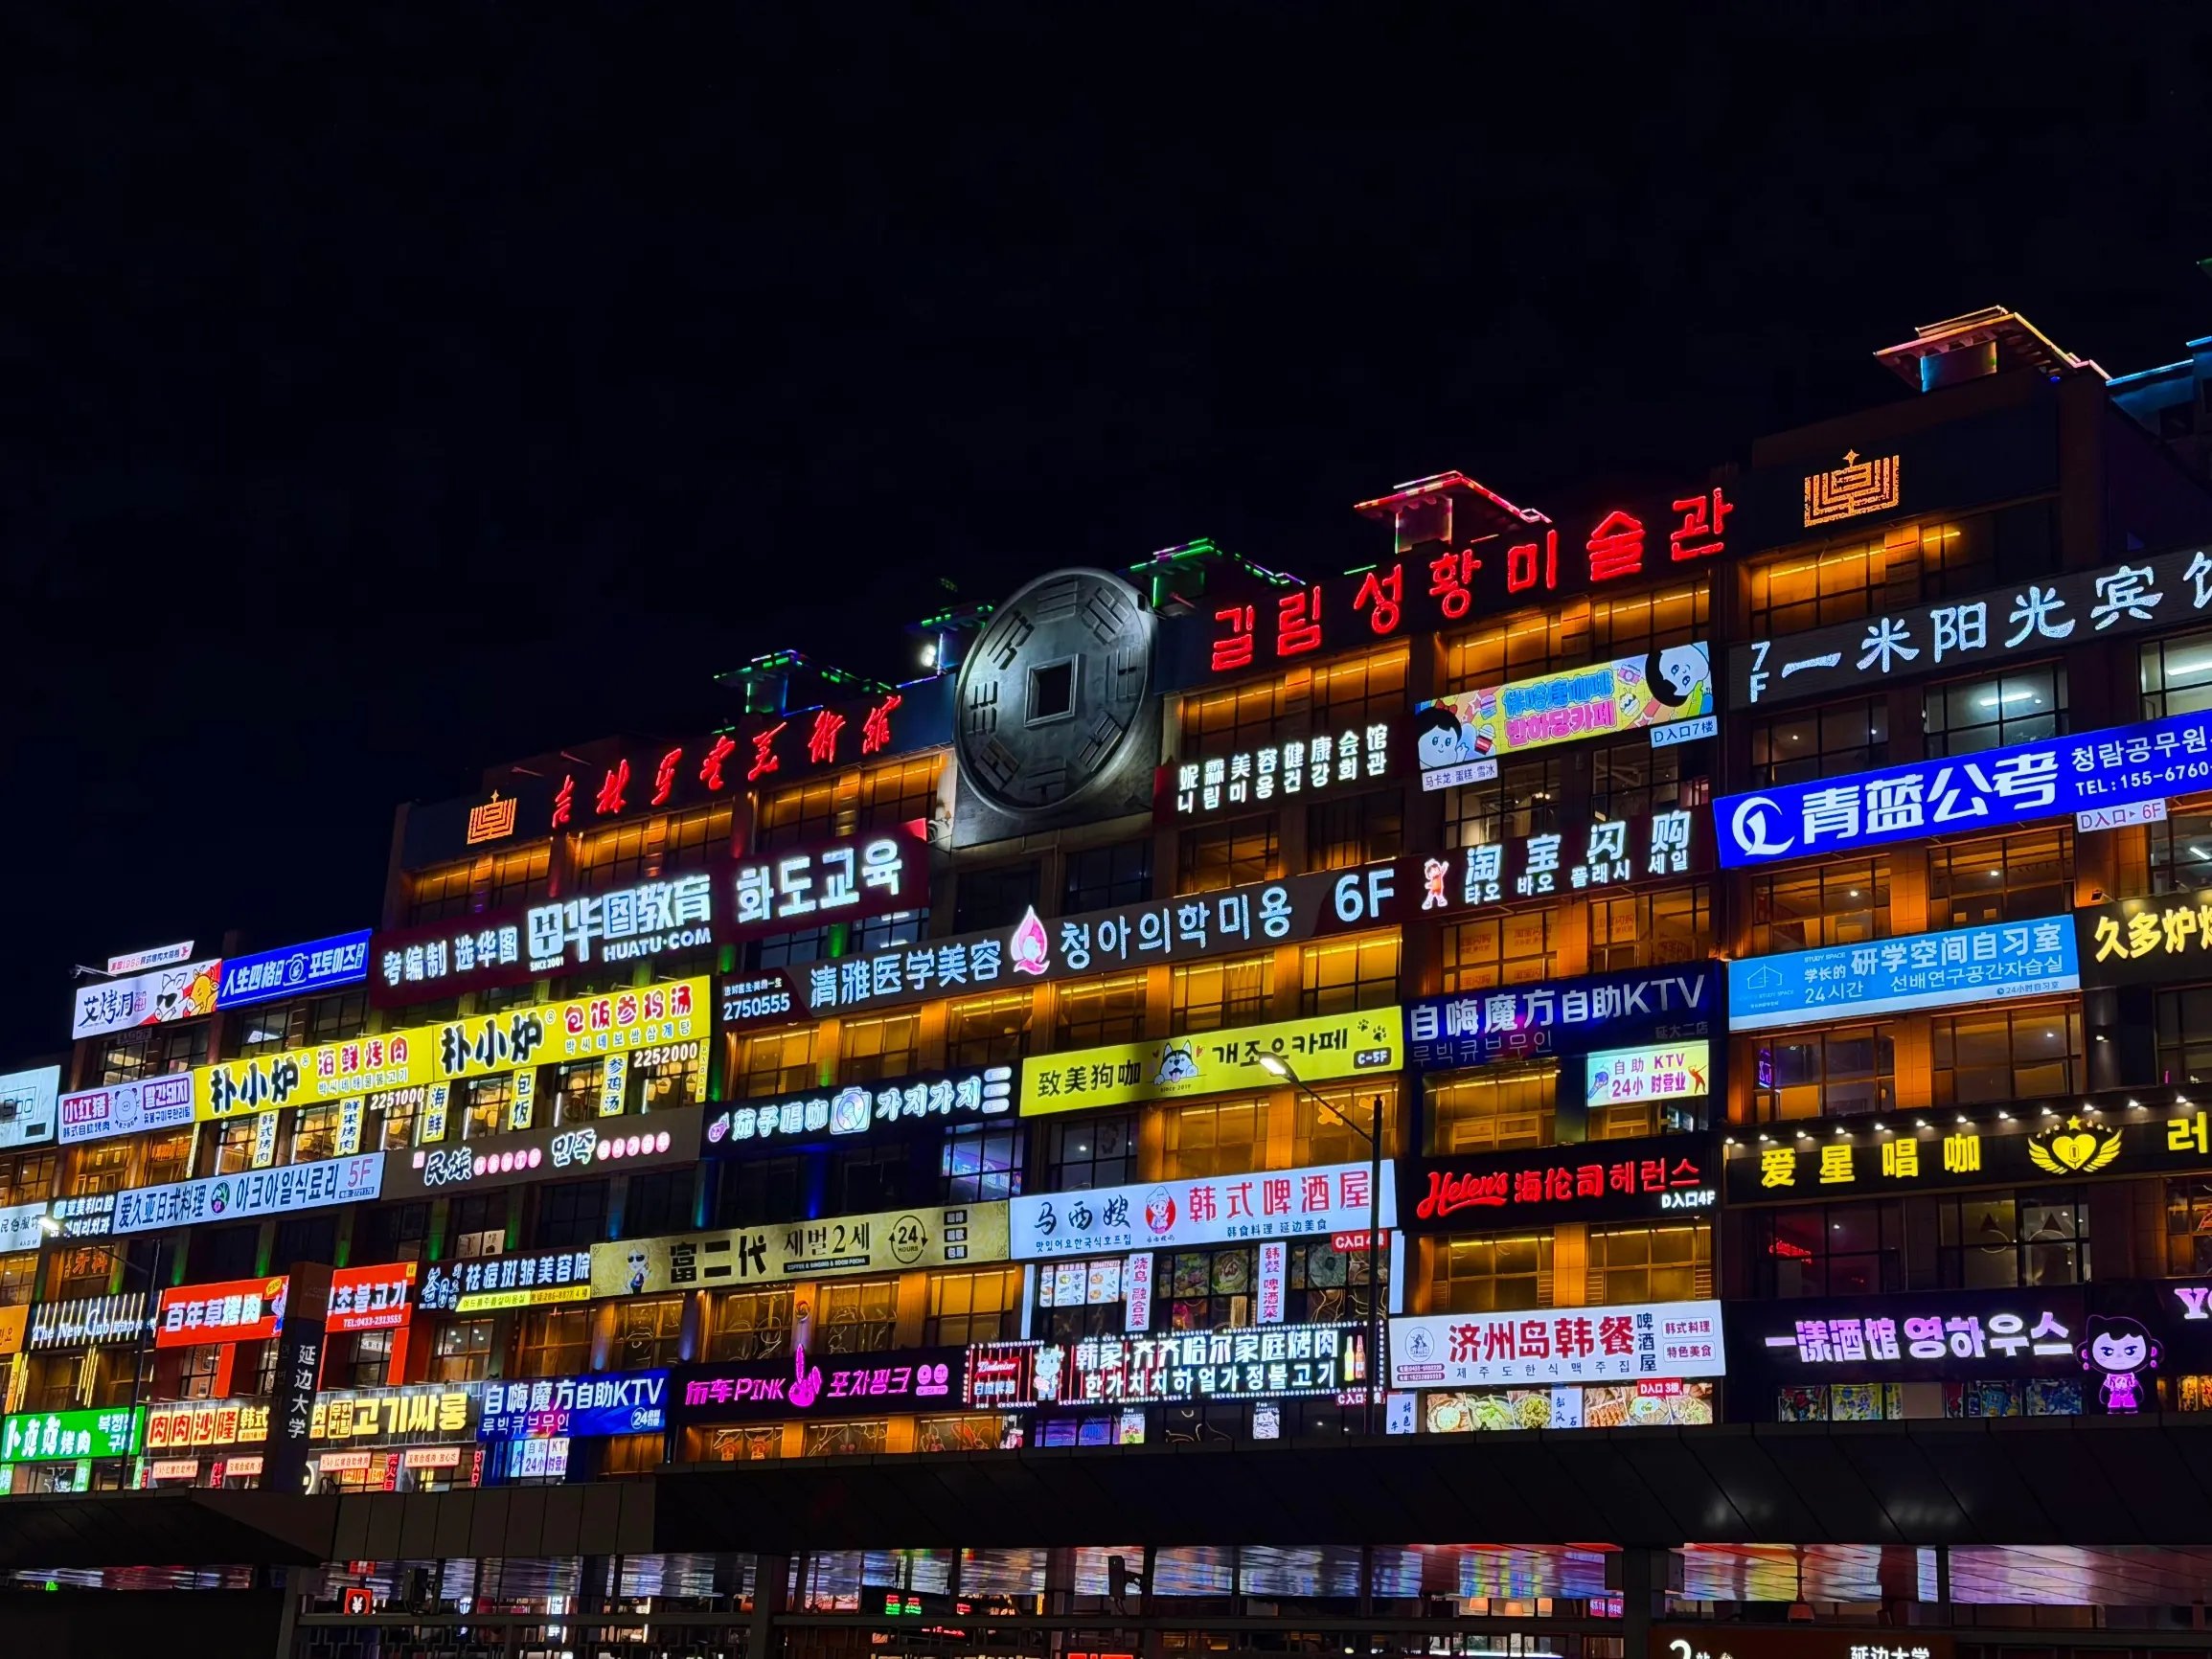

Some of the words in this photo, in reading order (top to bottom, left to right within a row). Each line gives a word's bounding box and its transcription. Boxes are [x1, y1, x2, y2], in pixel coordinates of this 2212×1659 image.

[1212, 488, 1733, 671] 길림성황미술관
[1176, 750, 1388, 814] 니림미용건강회관
[1801, 750, 2060, 845] 青蓝公考
[1465, 810, 1692, 887] 淘宝闪购
[737, 838, 902, 924] 화도교육
[1334, 868, 1396, 923] 6F
[563, 873, 712, 963] 华图教育
[1060, 886, 1293, 970] 청아의학미용
[384, 940, 447, 987] 考编制
[455, 926, 518, 974] 选华图
[1851, 923, 2064, 976] 研学空间自习室
[810, 939, 1002, 1009] 清雅医学美容
[1804, 964, 1847, 984] 学长的
[1805, 980, 1864, 1005] 24시간
[1890, 955, 2064, 994] 선배연구공간자습실
[723, 992, 791, 1021] 2750555
[317, 1036, 409, 1078] 海鲜烤肉
[440, 1011, 544, 1076] 朴小炉
[633, 1043, 697, 1069] 2252000
[1357, 1050, 1389, 1065] C-5F
[1613, 1057, 1644, 1075] 自助
[1653, 1054, 1686, 1070] KTV
[209, 1056, 300, 1115] 朴小炉
[370, 1087, 425, 1111] 2251000
[513, 1072, 534, 1126] 包饭
[876, 1075, 981, 1121] 가지가지
[1038, 1058, 1142, 1098] 致美狗咖
[64, 1095, 106, 1123] 小红猪
[424, 1084, 447, 1142] 海鲜
[731, 1100, 829, 1141] 茄子唱咖
[256, 1113, 275, 1164] 韩式烤肉
[551, 1126, 598, 1168] 민족
[1761, 1132, 1981, 1189] 爱星唱咖
[347, 1158, 374, 1188] 5F
[423, 1146, 473, 1187] 民族
[1514, 1164, 1605, 1204] 海伦司
[1609, 1157, 1700, 1194] 헤런스
[118, 1184, 207, 1229] 爱久亚日式料理
[1189, 1170, 1372, 1224] 韩式啤酒屋
[783, 1221, 871, 1259] 재벌2세
[898, 1224, 919, 1245] 24
[1279, 1218, 1328, 1234] 延边美食
[671, 1234, 767, 1284] 富二代
[166, 1294, 262, 1331] 百年草烤肉
[1665, 1321, 1712, 1335] 韩式料理
[1448, 1314, 1635, 1364] 济州岛韩餐
[1666, 1344, 1713, 1358] 特色美食
[1903, 1311, 2074, 1360] 영하우스
[827, 1367, 912, 1398] 포차핑크
[1083, 1362, 1335, 1398] 한가치치하얼가정불고기
[1456, 1359, 1630, 1379] 제주도한식맥주집
[287, 1344, 317, 1439] 延边大学
[352, 1392, 468, 1436] 고기싸롱
